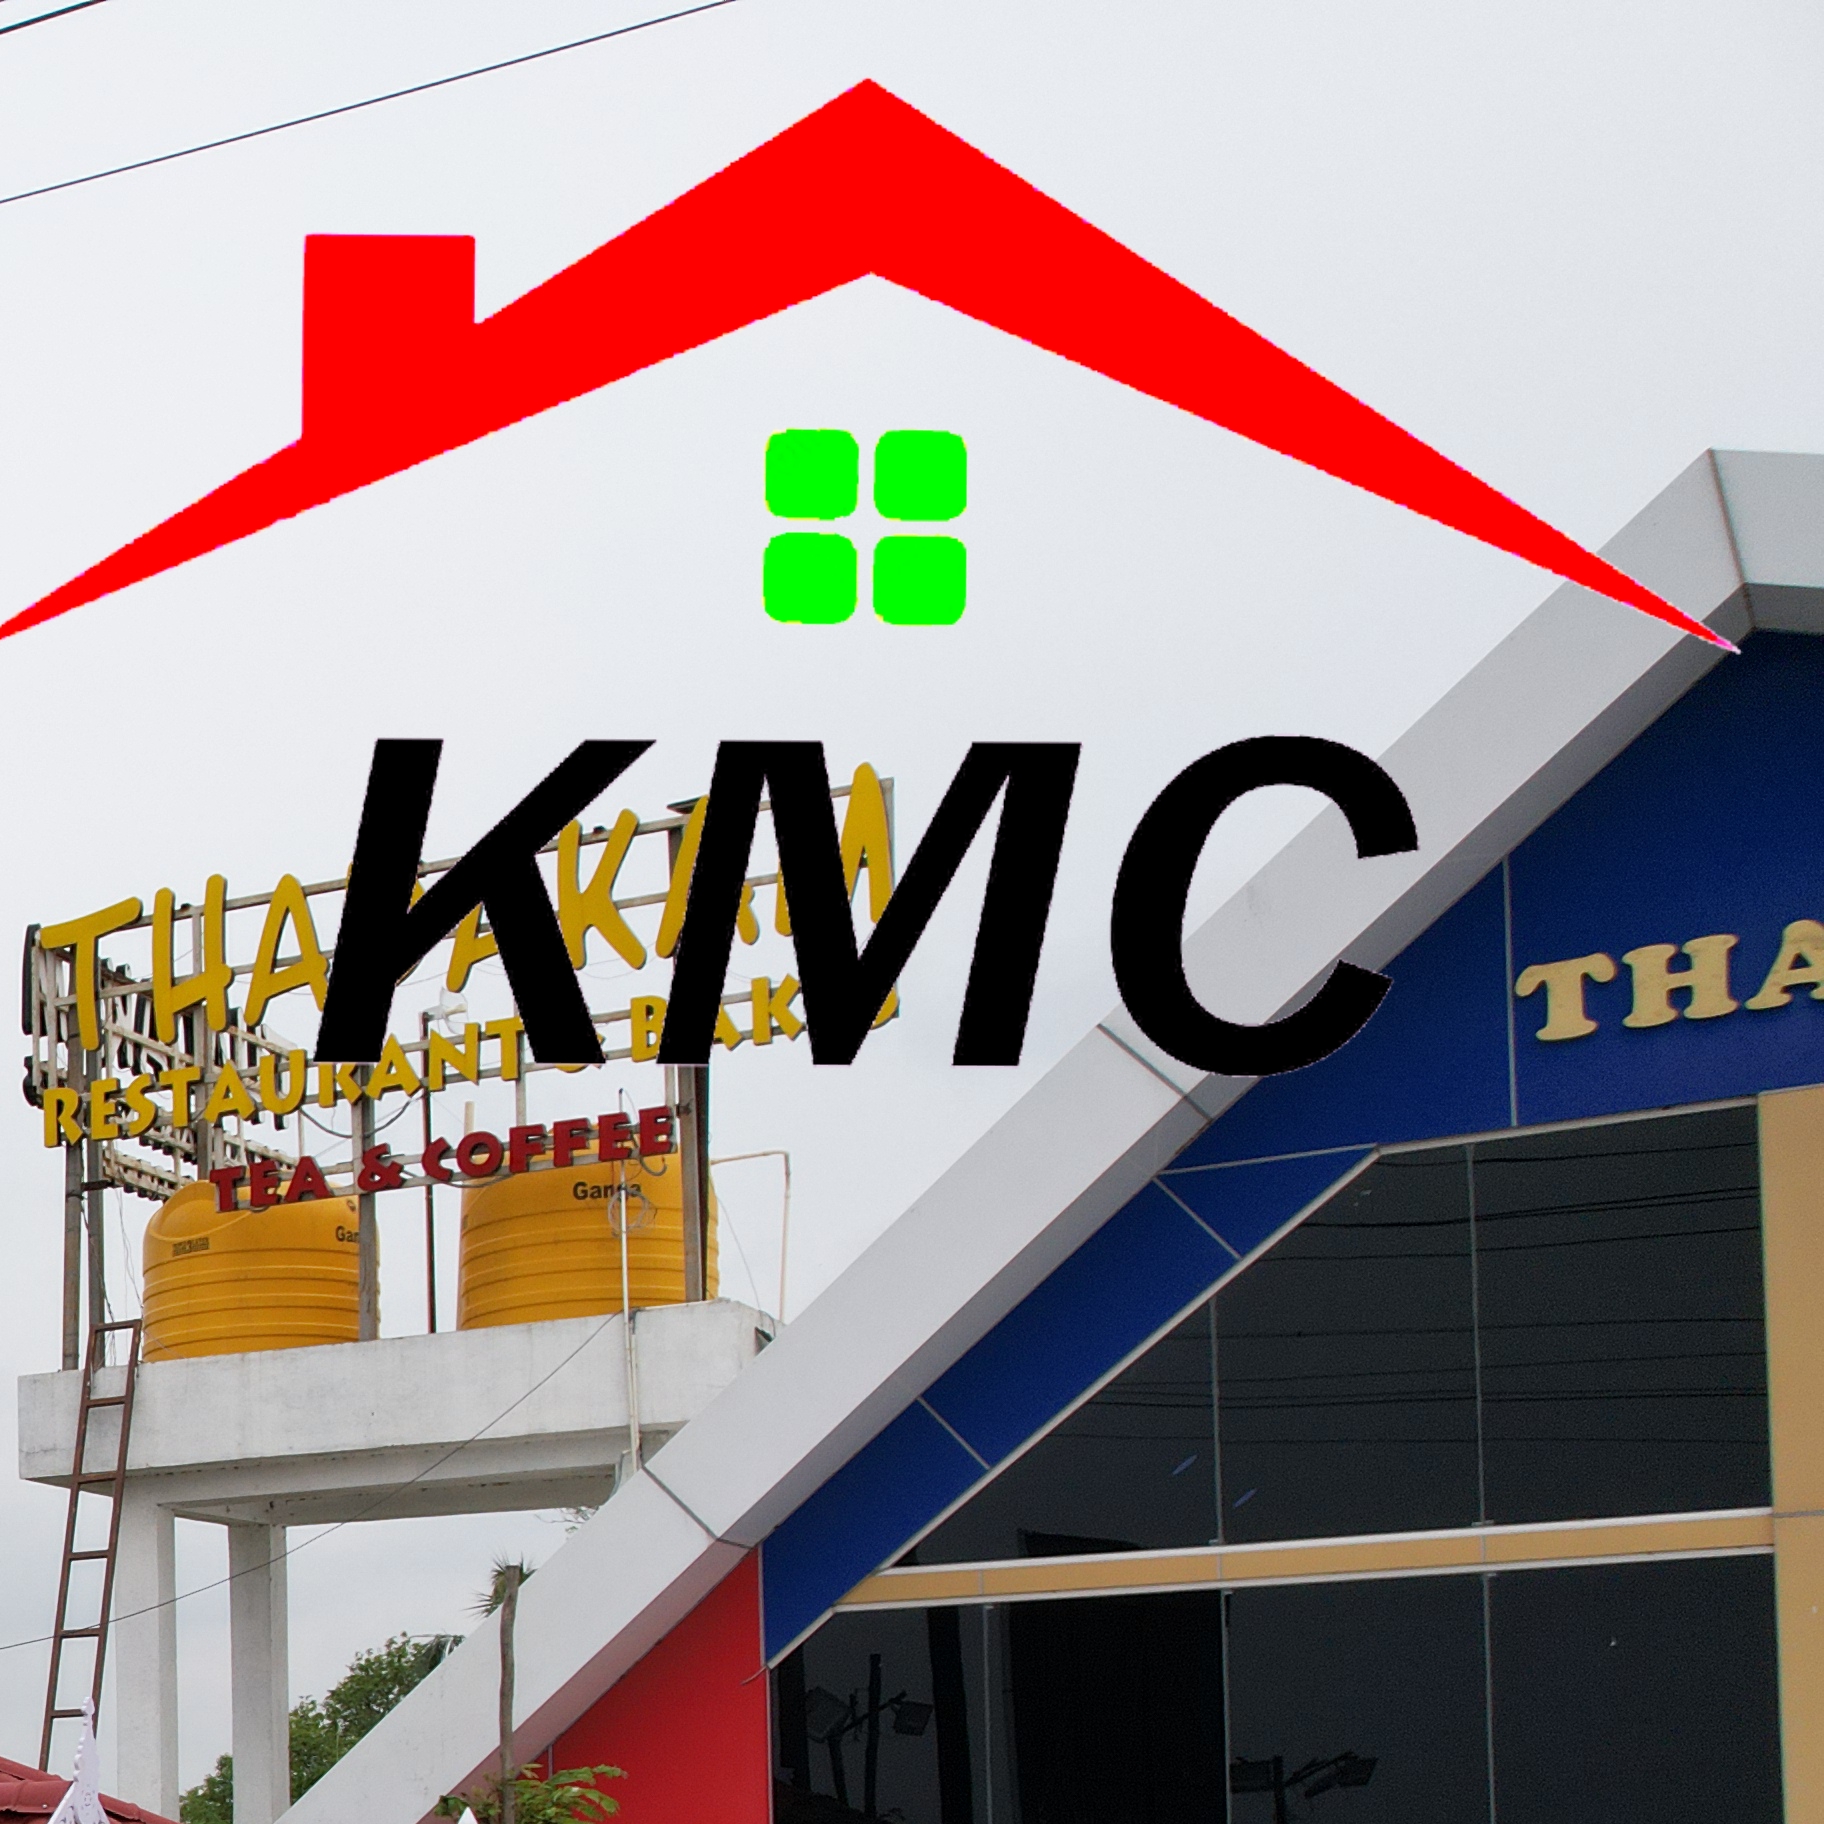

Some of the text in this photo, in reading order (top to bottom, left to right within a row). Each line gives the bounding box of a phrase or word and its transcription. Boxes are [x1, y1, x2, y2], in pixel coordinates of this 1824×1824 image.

[1514, 918, 1824, 1041] THA
[209, 1155, 334, 1213] TEA
[357, 1142, 404, 1192] &
[421, 1106, 675, 1182] COFFEE
